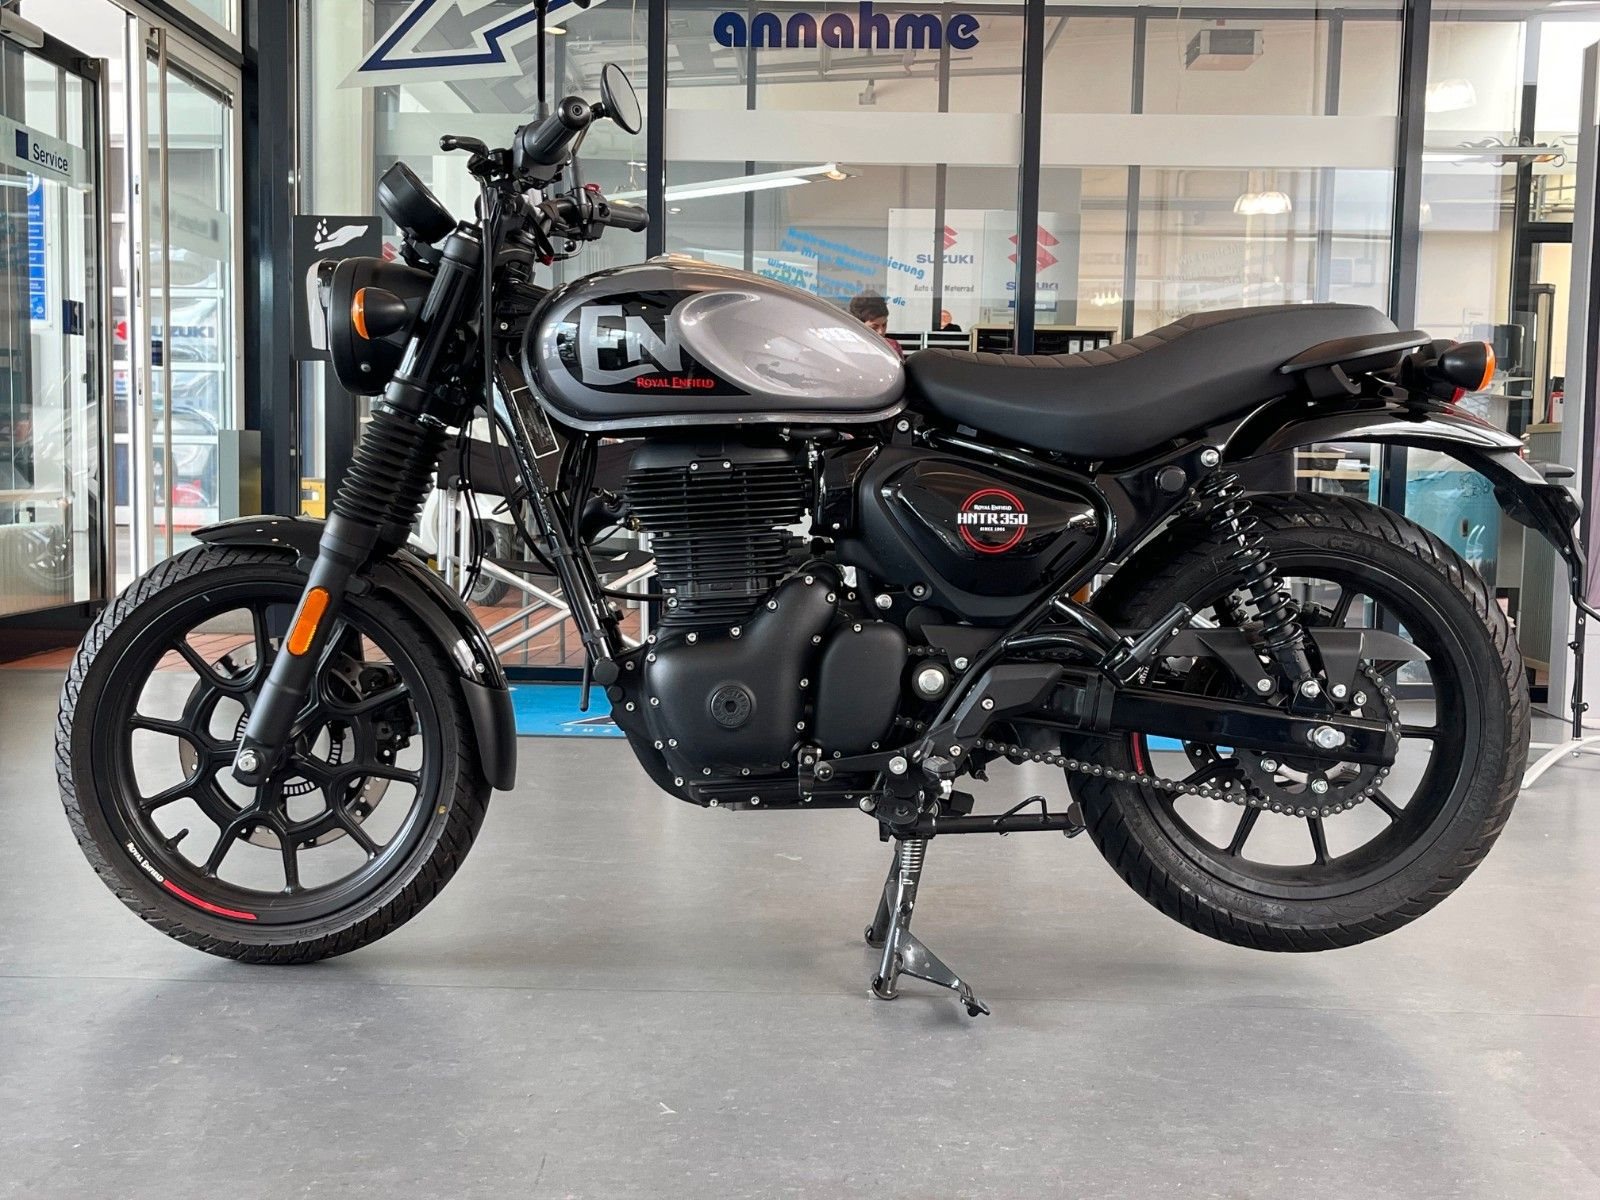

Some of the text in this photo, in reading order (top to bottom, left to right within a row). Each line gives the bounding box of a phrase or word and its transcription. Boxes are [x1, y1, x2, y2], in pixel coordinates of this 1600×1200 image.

[713, 1, 980, 50] annahme
[33, 143, 69, 171] Service
[1006, 281, 1059, 290] SUKI
[151, 325, 215, 338] UZUKI
[636, 376, 714, 389] ROYAL ENFIELD
[957, 512, 1028, 525] HNTR 350
[127, 842, 164, 882] ROYAL ENFIELD
